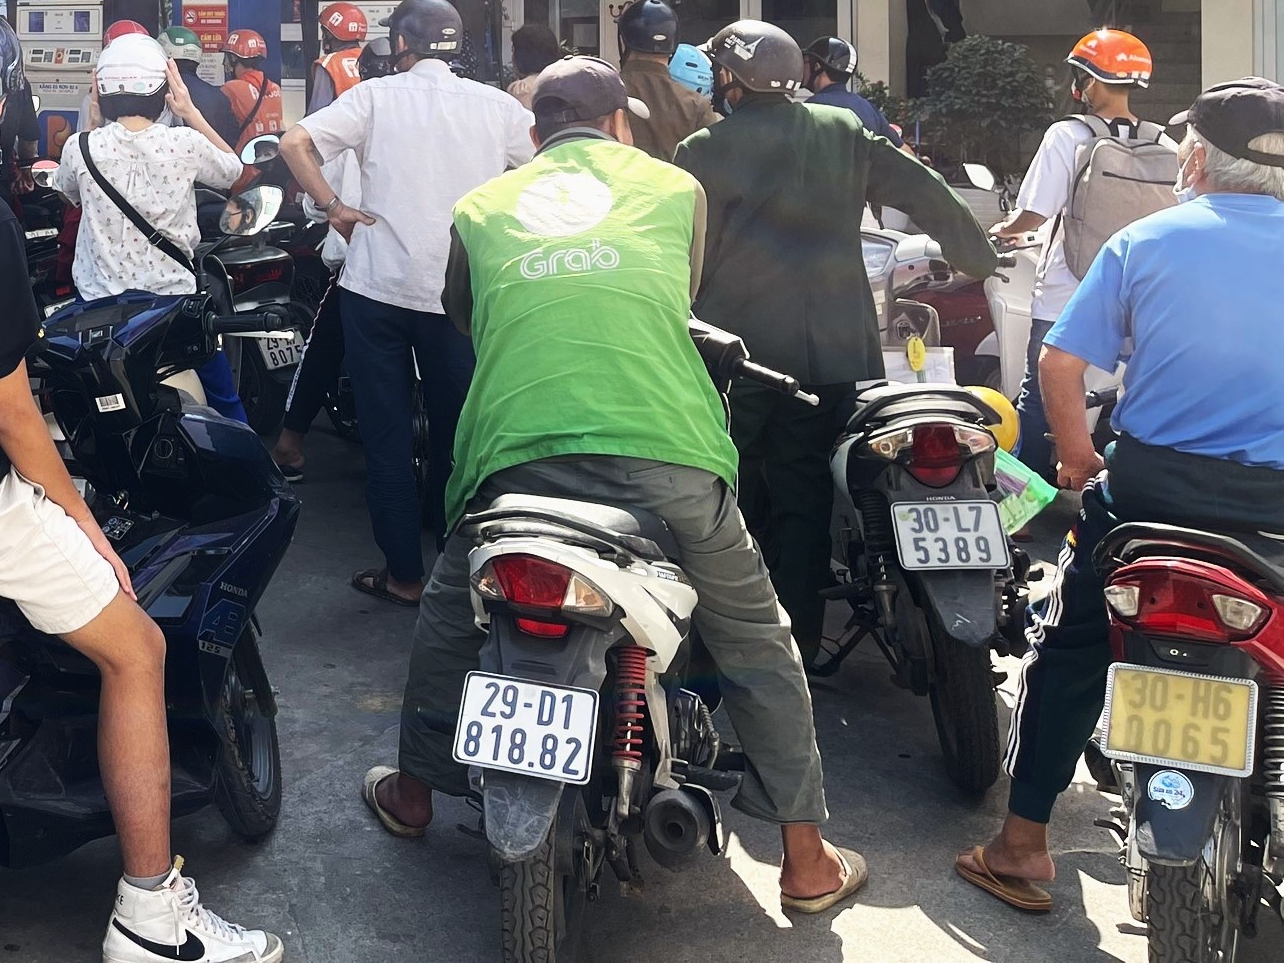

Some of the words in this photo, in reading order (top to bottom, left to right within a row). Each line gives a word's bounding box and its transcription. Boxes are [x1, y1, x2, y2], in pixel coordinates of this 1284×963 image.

[519, 239, 621, 280] Grab
[907, 505, 982, 534] 30-L7
[912, 536, 992, 565] 5389
[219, 581, 248, 598] HONDA
[201, 641, 221, 654] 125
[480, 682, 574, 730] 29-D1
[1128, 672, 1233, 721] 30-H6
[463, 720, 582, 776] 818.82
[1124, 714, 1231, 765] 0065
